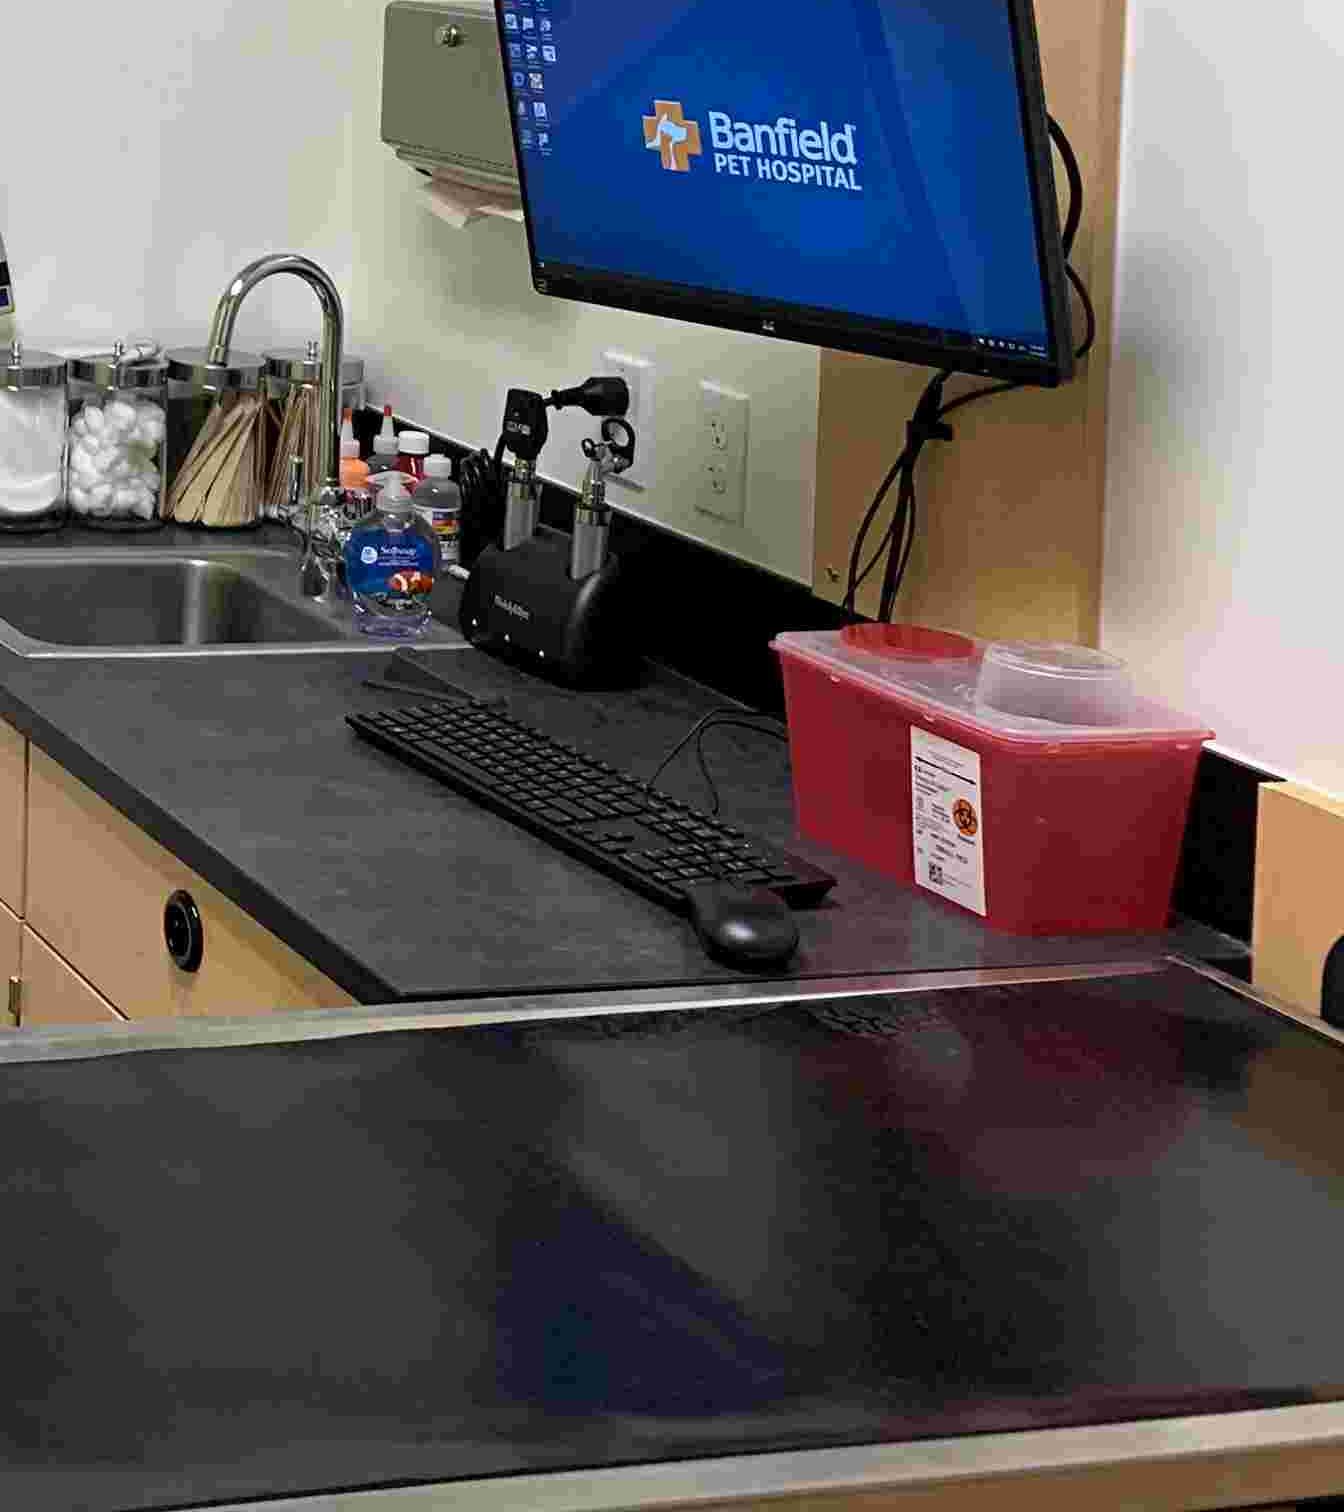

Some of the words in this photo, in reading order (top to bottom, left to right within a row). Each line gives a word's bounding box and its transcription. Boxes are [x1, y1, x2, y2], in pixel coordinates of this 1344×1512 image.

[709, 111, 858, 165] Banfield
[714, 152, 751, 177] PET
[757, 156, 862, 191] HOSPITAL
